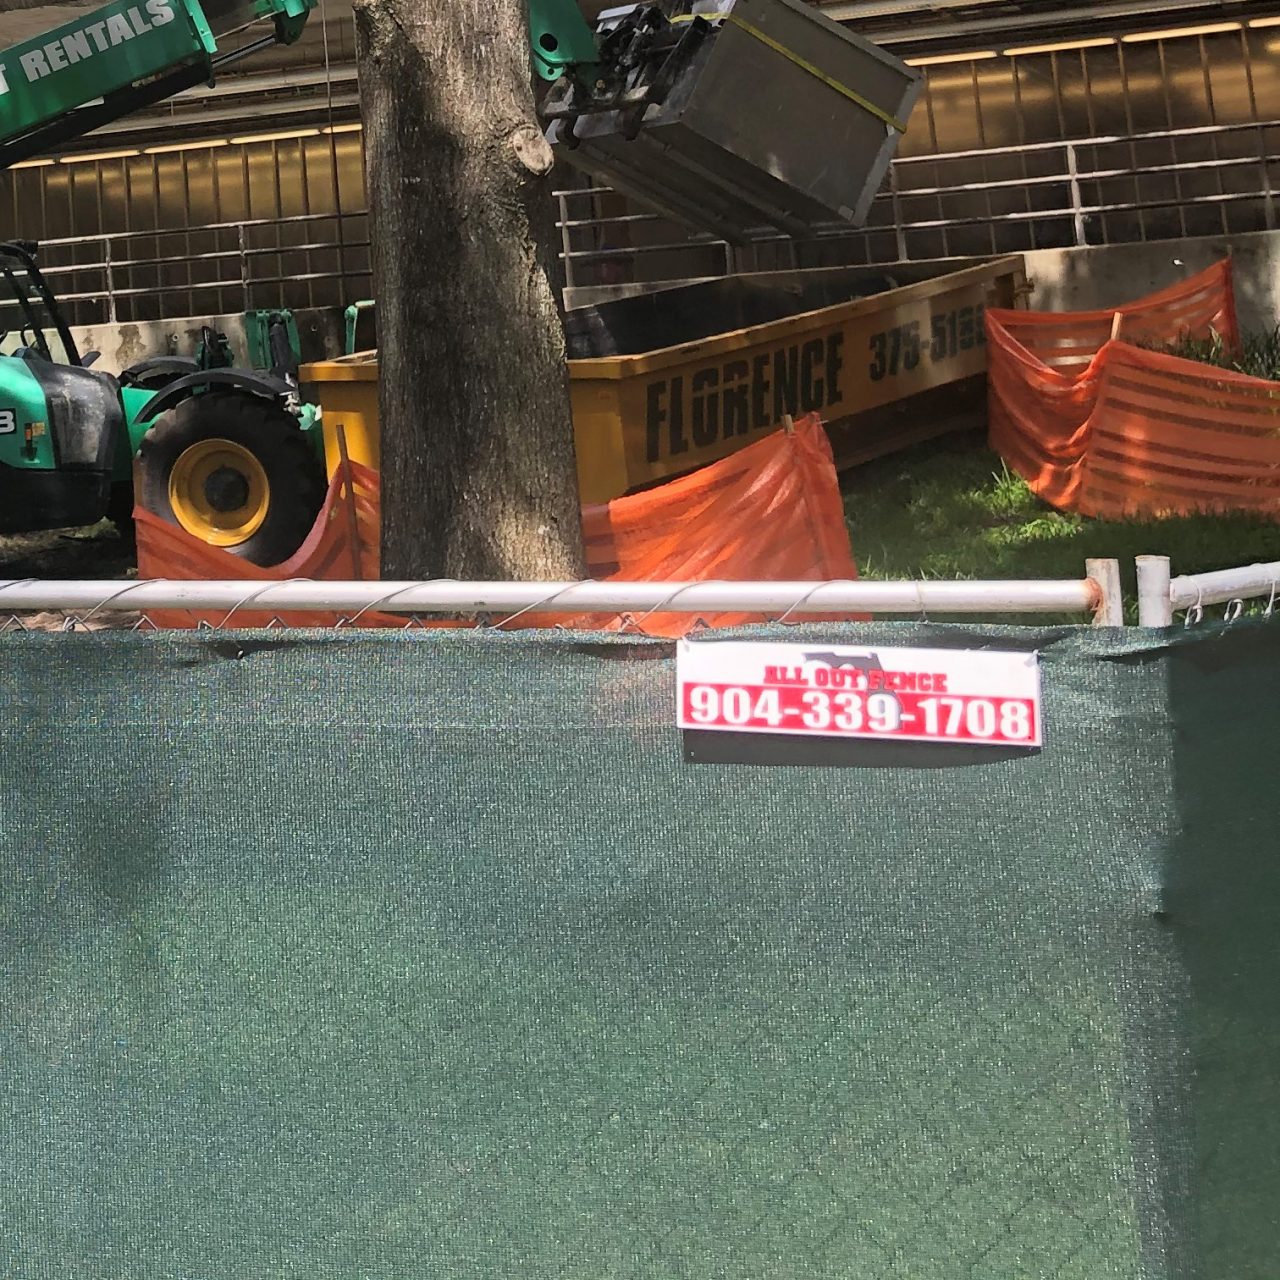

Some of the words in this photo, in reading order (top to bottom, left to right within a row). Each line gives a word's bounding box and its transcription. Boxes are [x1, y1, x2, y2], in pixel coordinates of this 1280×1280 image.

[647, 331, 845, 462] FLORENCE
[764, 665, 809, 685] ALL
[815, 667, 863, 688] OUT
[869, 670, 947, 692] FENCE
[690, 686, 1029, 739] 904-339-1708
